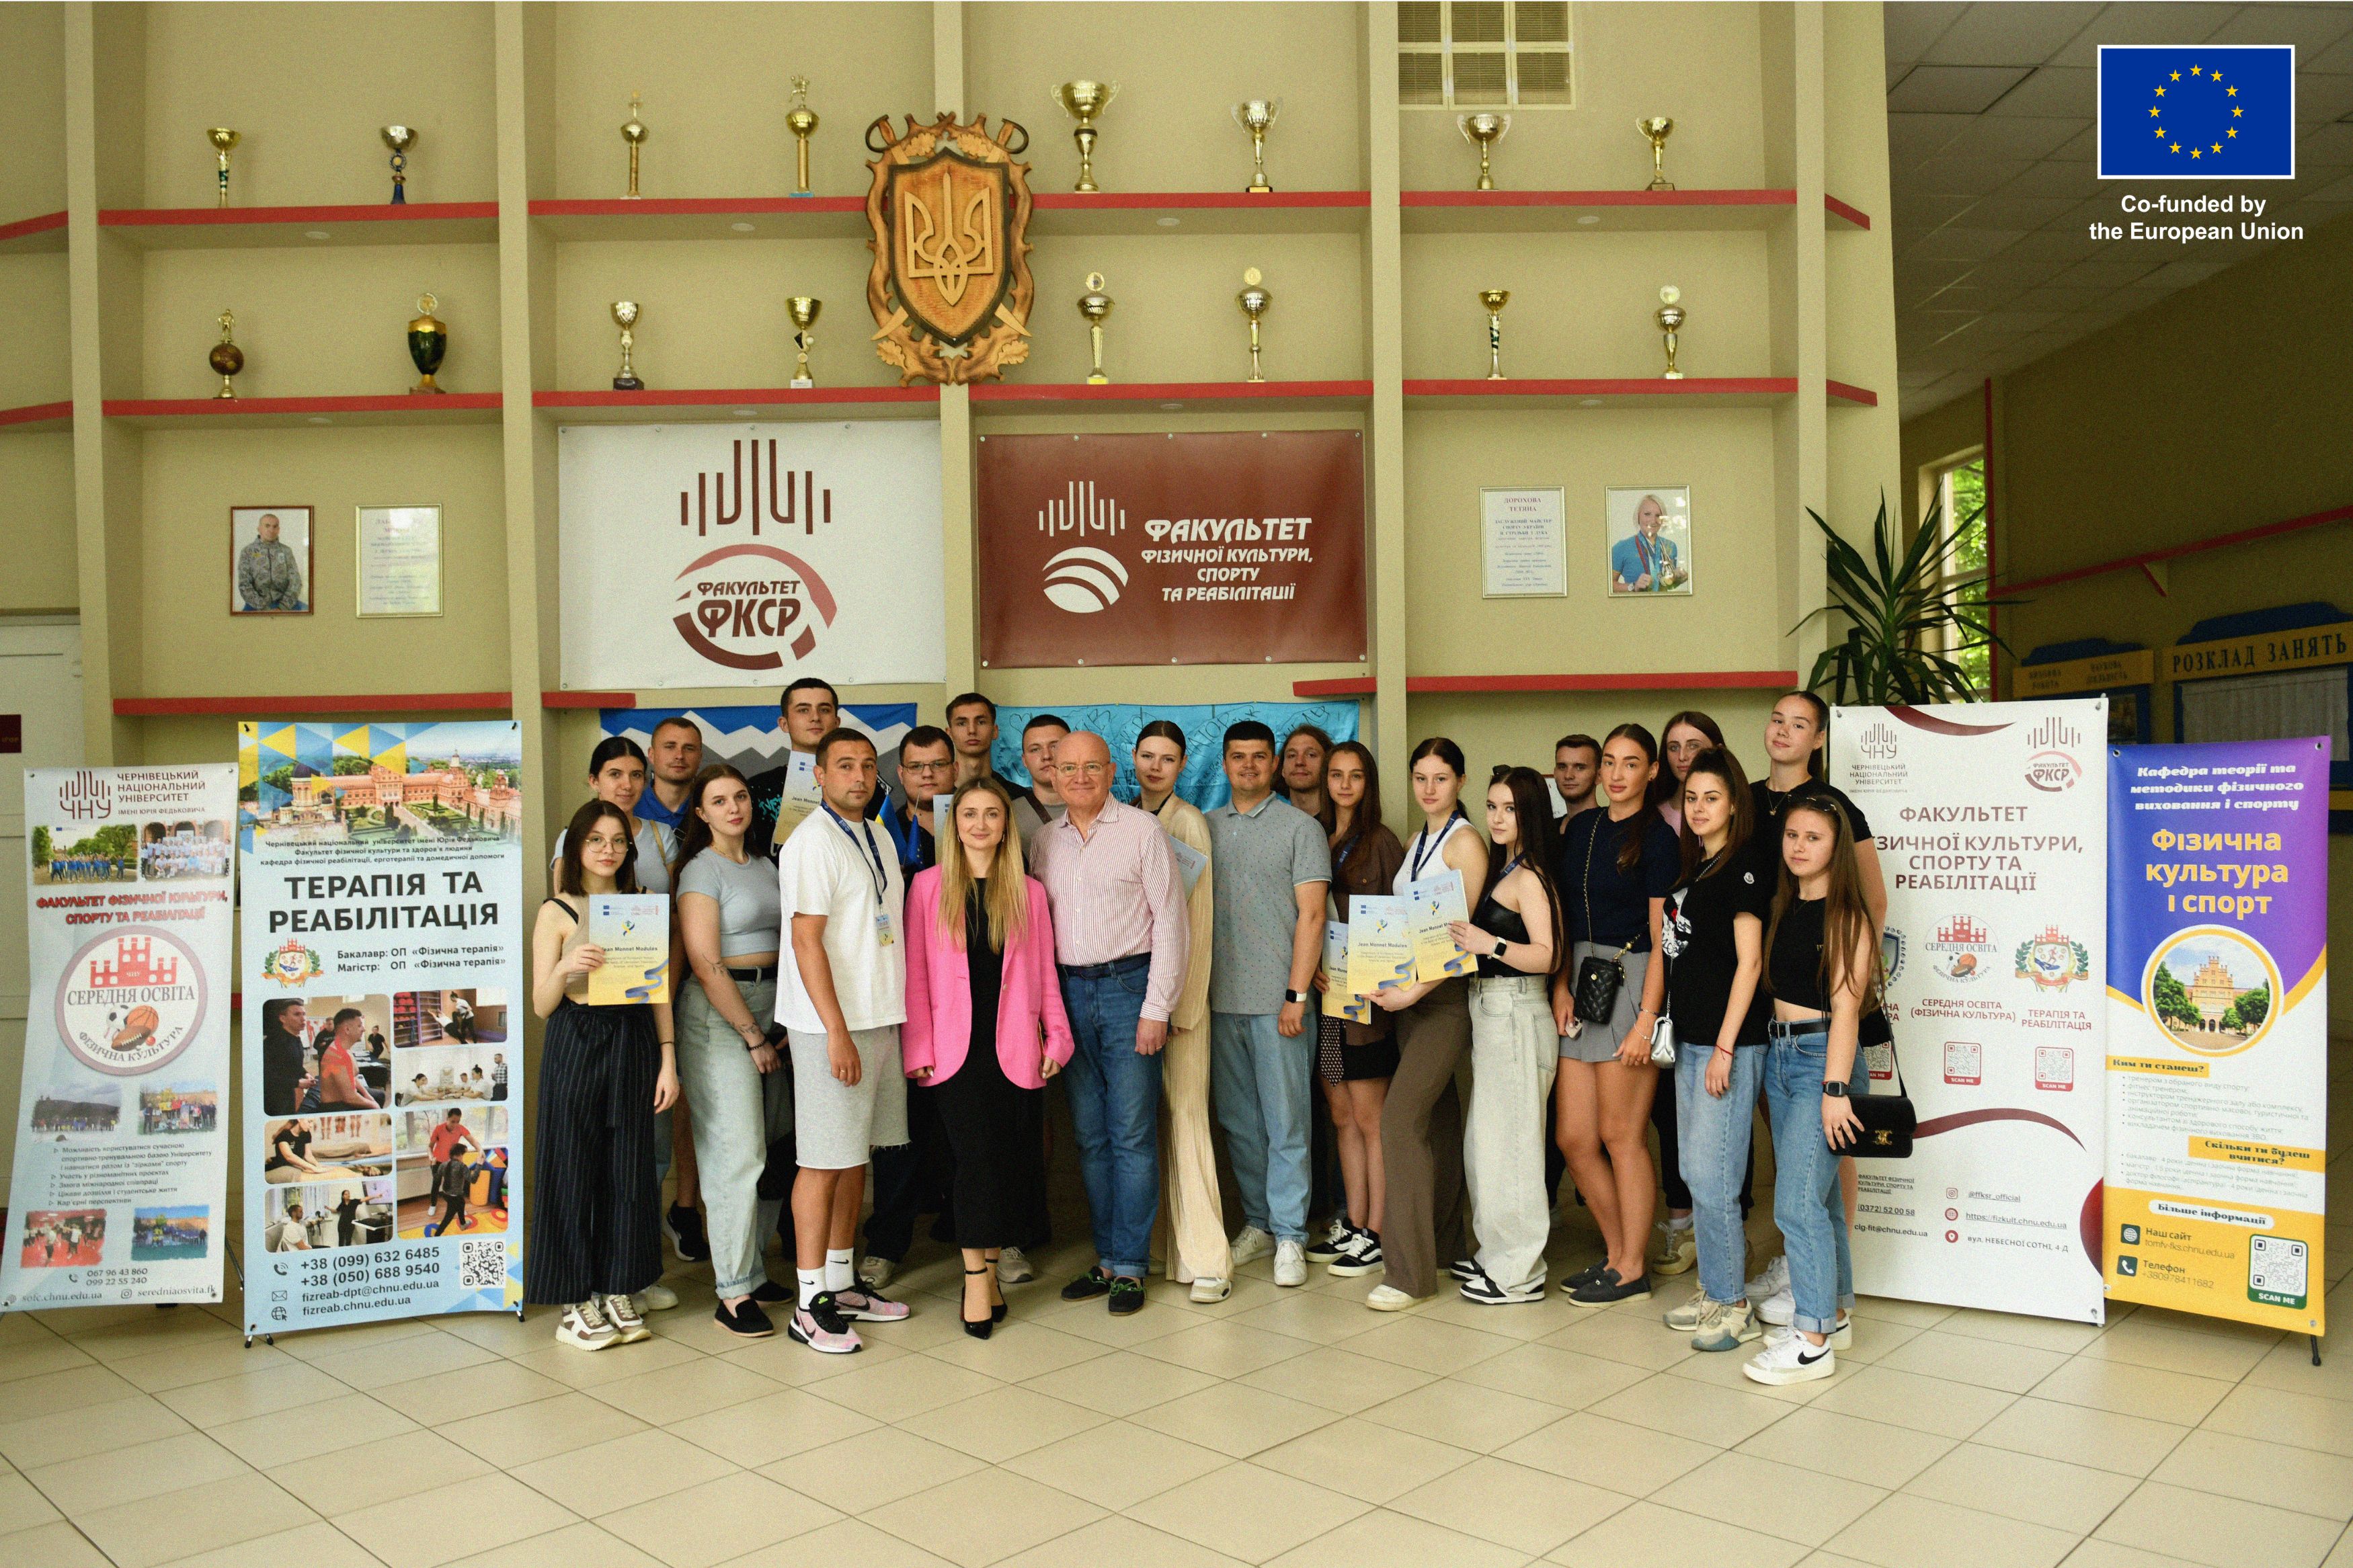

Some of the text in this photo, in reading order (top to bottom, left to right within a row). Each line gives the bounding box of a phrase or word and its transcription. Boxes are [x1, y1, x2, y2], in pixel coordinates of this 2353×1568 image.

[1144, 518, 1312, 544] ФАКУЛЬТЕТ
[1142, 546, 1313, 563] ФІЗИЧНОЇ КУЛЬТУРИ,
[1197, 567, 1260, 582] СПОРТУ
[697, 581, 801, 597] ФАКУЛЬТЕТ
[1162, 583, 1295, 602] ТА РЕАБІЛІТАЦІЇ
[697, 597, 801, 638] ФКСР
[2173, 632, 2347, 673] РОЗКЛАД ЗАНЯТЬ
[1860, 744, 1897, 759] ЧНУ
[118, 770, 198, 781] ЧЕРНІВЕЦЬКИЙ
[1849, 770, 1908, 779] НАЦІОНАЛЬНИЙ
[2033, 768, 2070, 782] ФКСР
[2137, 766, 2208, 778] Кафедра
[2212, 764, 2266, 776] теорії
[118, 780, 205, 792] НАЦІОНАЛЬНИЙ
[2130, 782, 2304, 794] методики фізичного
[118, 793, 189, 802] УНІВЕРСИТЕТ
[2135, 799, 2299, 811] виховання і спорту
[60, 799, 111, 819] ЧНУ
[1899, 807, 2028, 822] ФАКУЛЬТЕТ
[266, 840, 317, 848] Чернівецький
[372, 838, 415, 846] університет
[437, 837, 455, 845] Юрія
[456, 835, 500, 843] Федьковича
[1872, 833, 2083, 854] ЗИЧНОЇ КУЛЬТУРИ,
[2152, 829, 2282, 851] Фізична
[294, 848, 333, 856] Факультет
[335, 847, 366, 856] фізичної
[368, 847, 401, 855] культури
[444, 845, 473, 853] людини
[260, 858, 292, 867] кафедра
[294, 857, 326, 866] фізичної
[328, 856, 372, 864] реабілітації,
[374, 856, 415, 864] ерготерапії
[470, 853, 505, 861] допомоги
[1909, 855, 2022, 871] СПОРТУ ТА
[1896, 872, 2036, 894] РЕАБІЛІТАЦІЇ
[2146, 864, 2288, 889] культура
[284, 871, 483, 899] ТЕРАПІЯ ТА
[36, 895, 106, 908] ФАКУЛЬТЕТ
[108, 891, 167, 906] ФІЗИЧНОЇ
[2182, 895, 2272, 920] спорт
[66, 906, 205, 925] СПОРТУ ТА РЕАБІЛІТАЦІЇ
[270, 903, 498, 933] РЕАБІЛІТАЦІЯ
[337, 944, 504, 960] Бакалавр: ОП «Фізична терапія»
[337, 958, 506, 973] Магістр: ОП «Фізична терапія»
[67, 985, 195, 1007] СЕРЕДНЯ ОСВІТА
[1922, 999, 2002, 1009] СЕРЕДНЯ ОСВІТА
[1911, 1007, 1960, 1019] (ФІЗИЧНА
[1962, 1009, 2016, 1022] КУЛЬТУРА)
[2028, 1009, 2085, 1020] ТЕРАПІЯ ТА
[2022, 1019, 2092, 1031] РЕАБІЛІТАЦІЯ
[79, 1026, 183, 1061] ФІЗИЧНА КУЛЬТУРА
[2113, 1059, 2136, 1067] Ким
[2154, 1063, 2204, 1073] станеш?
[2205, 1141, 2310, 1159] Скільки ти будеш
[2229, 1153, 2285, 1165] вчитися?
[1968, 1190, 2021, 1202] @ffksr_official
[1858, 1204, 1881, 1212] (0372)
[2158, 1204, 2266, 1225] Більше інформації
[1966, 1212, 2067, 1229] https://fizkult.chnu.edu.ua
[2145, 1227, 2192, 1241] Наш сайт
[1968, 1237, 1984, 1245] вул.
[1985, 1237, 2025, 1247] НЕБЕСНОЇ
[2061, 1244, 2069, 1253] Д
[301, 1247, 440, 1272] +38 (099) 632 6485
[2143, 1260, 2186, 1274] Телефон
[301, 1263, 440, 1288] +38 (050) 688 9540
[137, 1285, 215, 1297] seredniaosvita.fk
[303, 1279, 440, 1303] fizreab-dpt@chnu.edu.ua
[2258, 1292, 2295, 1305] SCAN ME
[303, 1296, 411, 1315] fizreab.chnu.edu.ua
